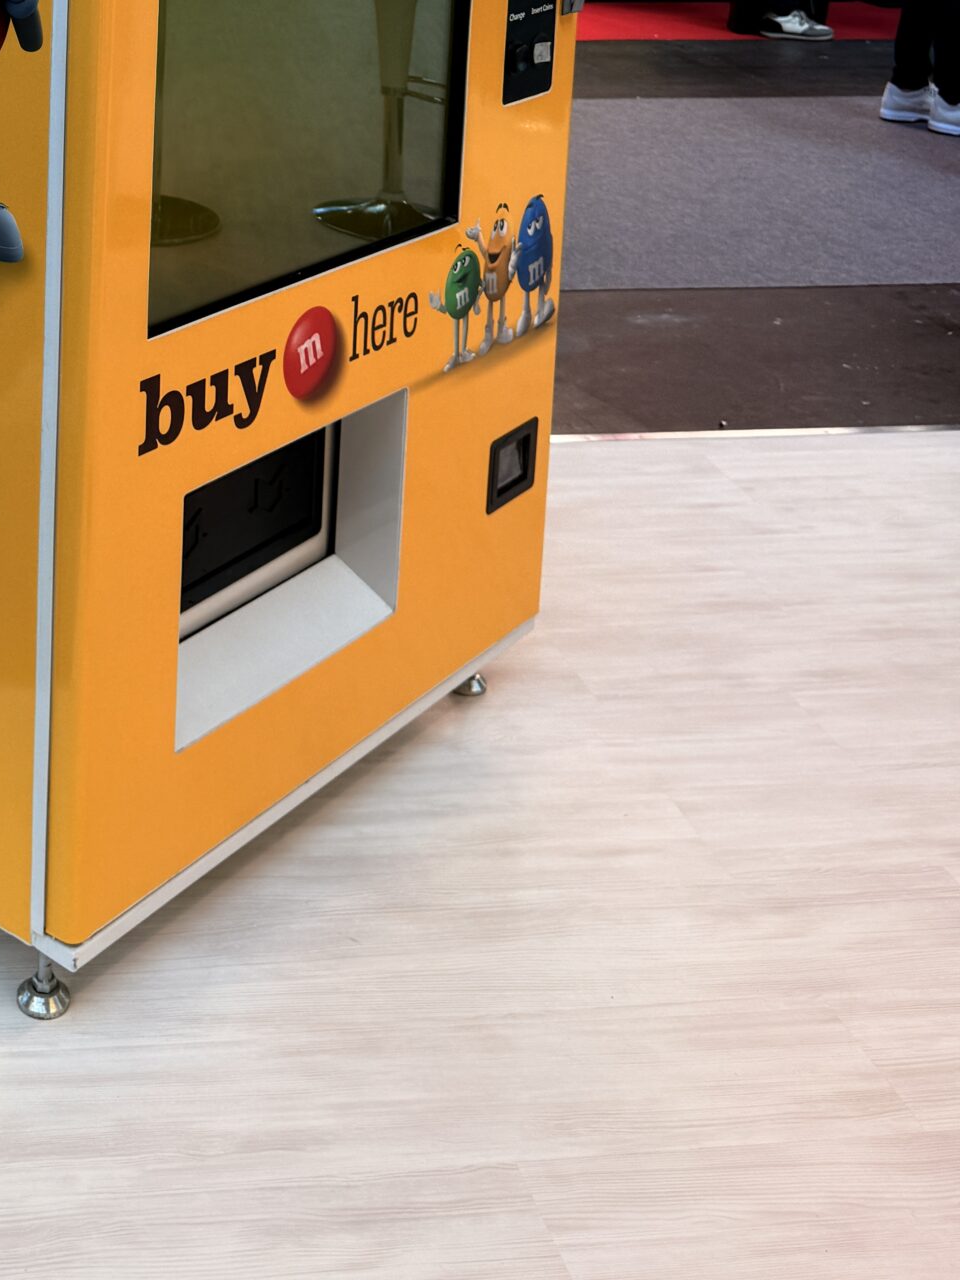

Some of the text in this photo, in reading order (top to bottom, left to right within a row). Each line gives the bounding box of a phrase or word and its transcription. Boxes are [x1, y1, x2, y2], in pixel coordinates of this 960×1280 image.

[531, 3, 553, 14] Insert Coins
[509, 12, 525, 21] Change
[138, 292, 418, 457] buy m here
